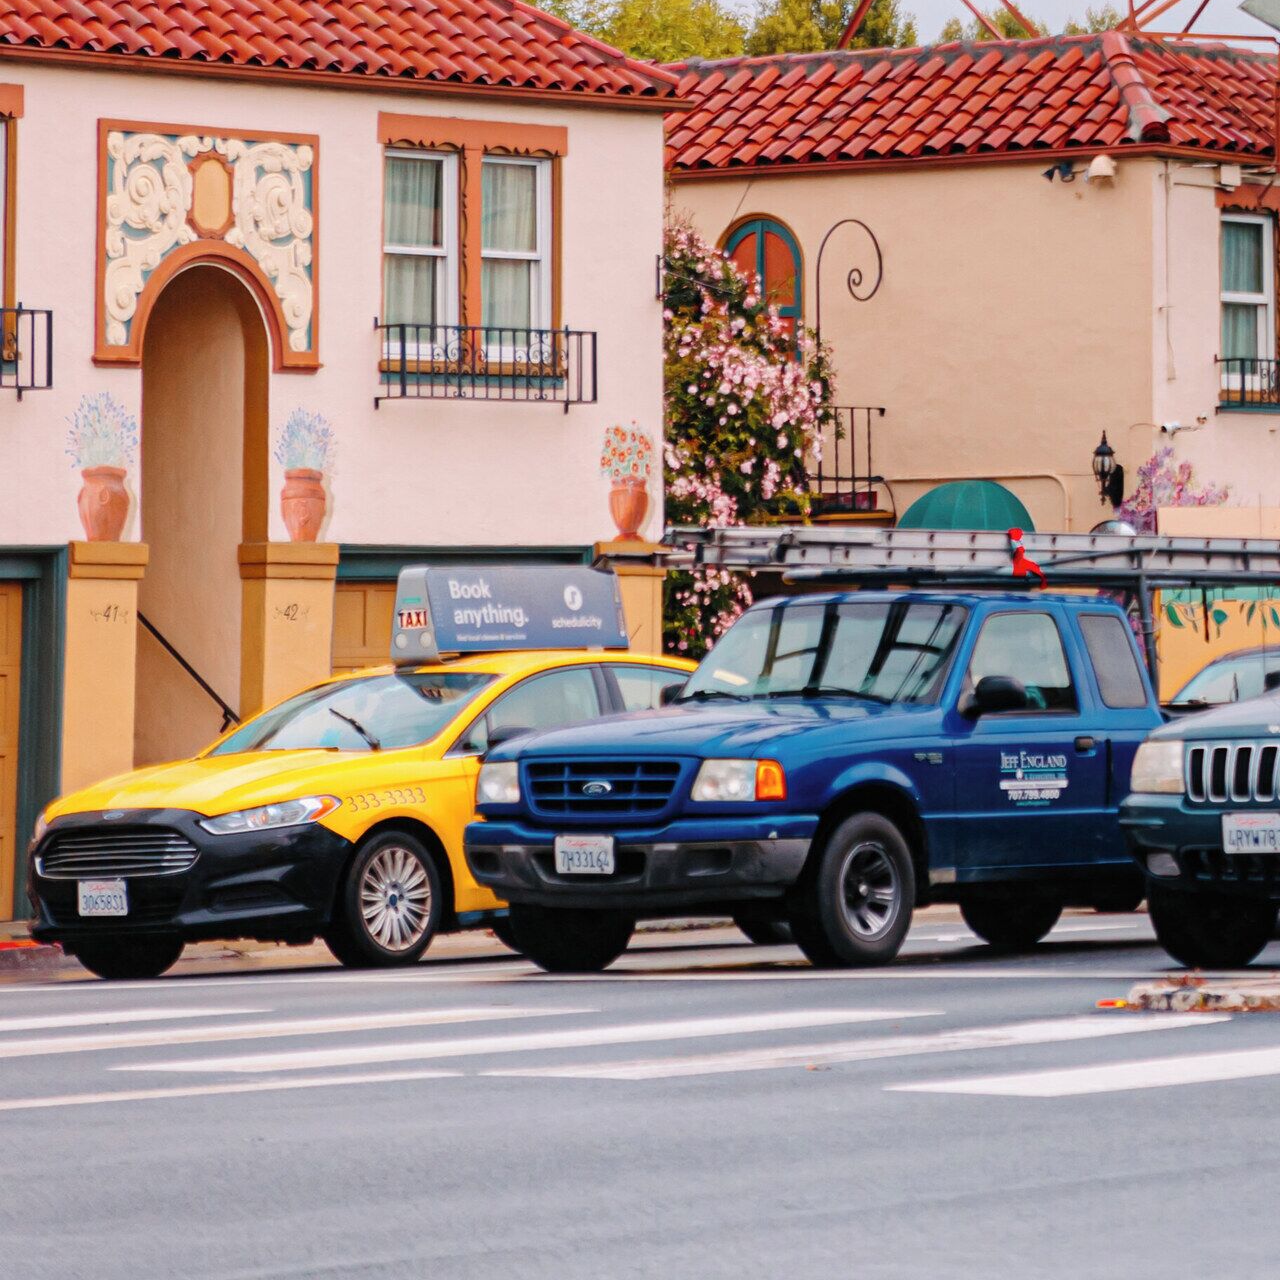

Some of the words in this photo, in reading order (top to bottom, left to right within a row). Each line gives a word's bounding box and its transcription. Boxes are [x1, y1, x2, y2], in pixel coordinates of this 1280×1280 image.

[448, 578, 492, 600] Book
[283, 604, 299, 621] 42
[399, 609, 428, 629] TAXI
[454, 603, 530, 628] anything.
[552, 616, 602, 630] schedulicity
[345, 787, 427, 813] 333-3333
